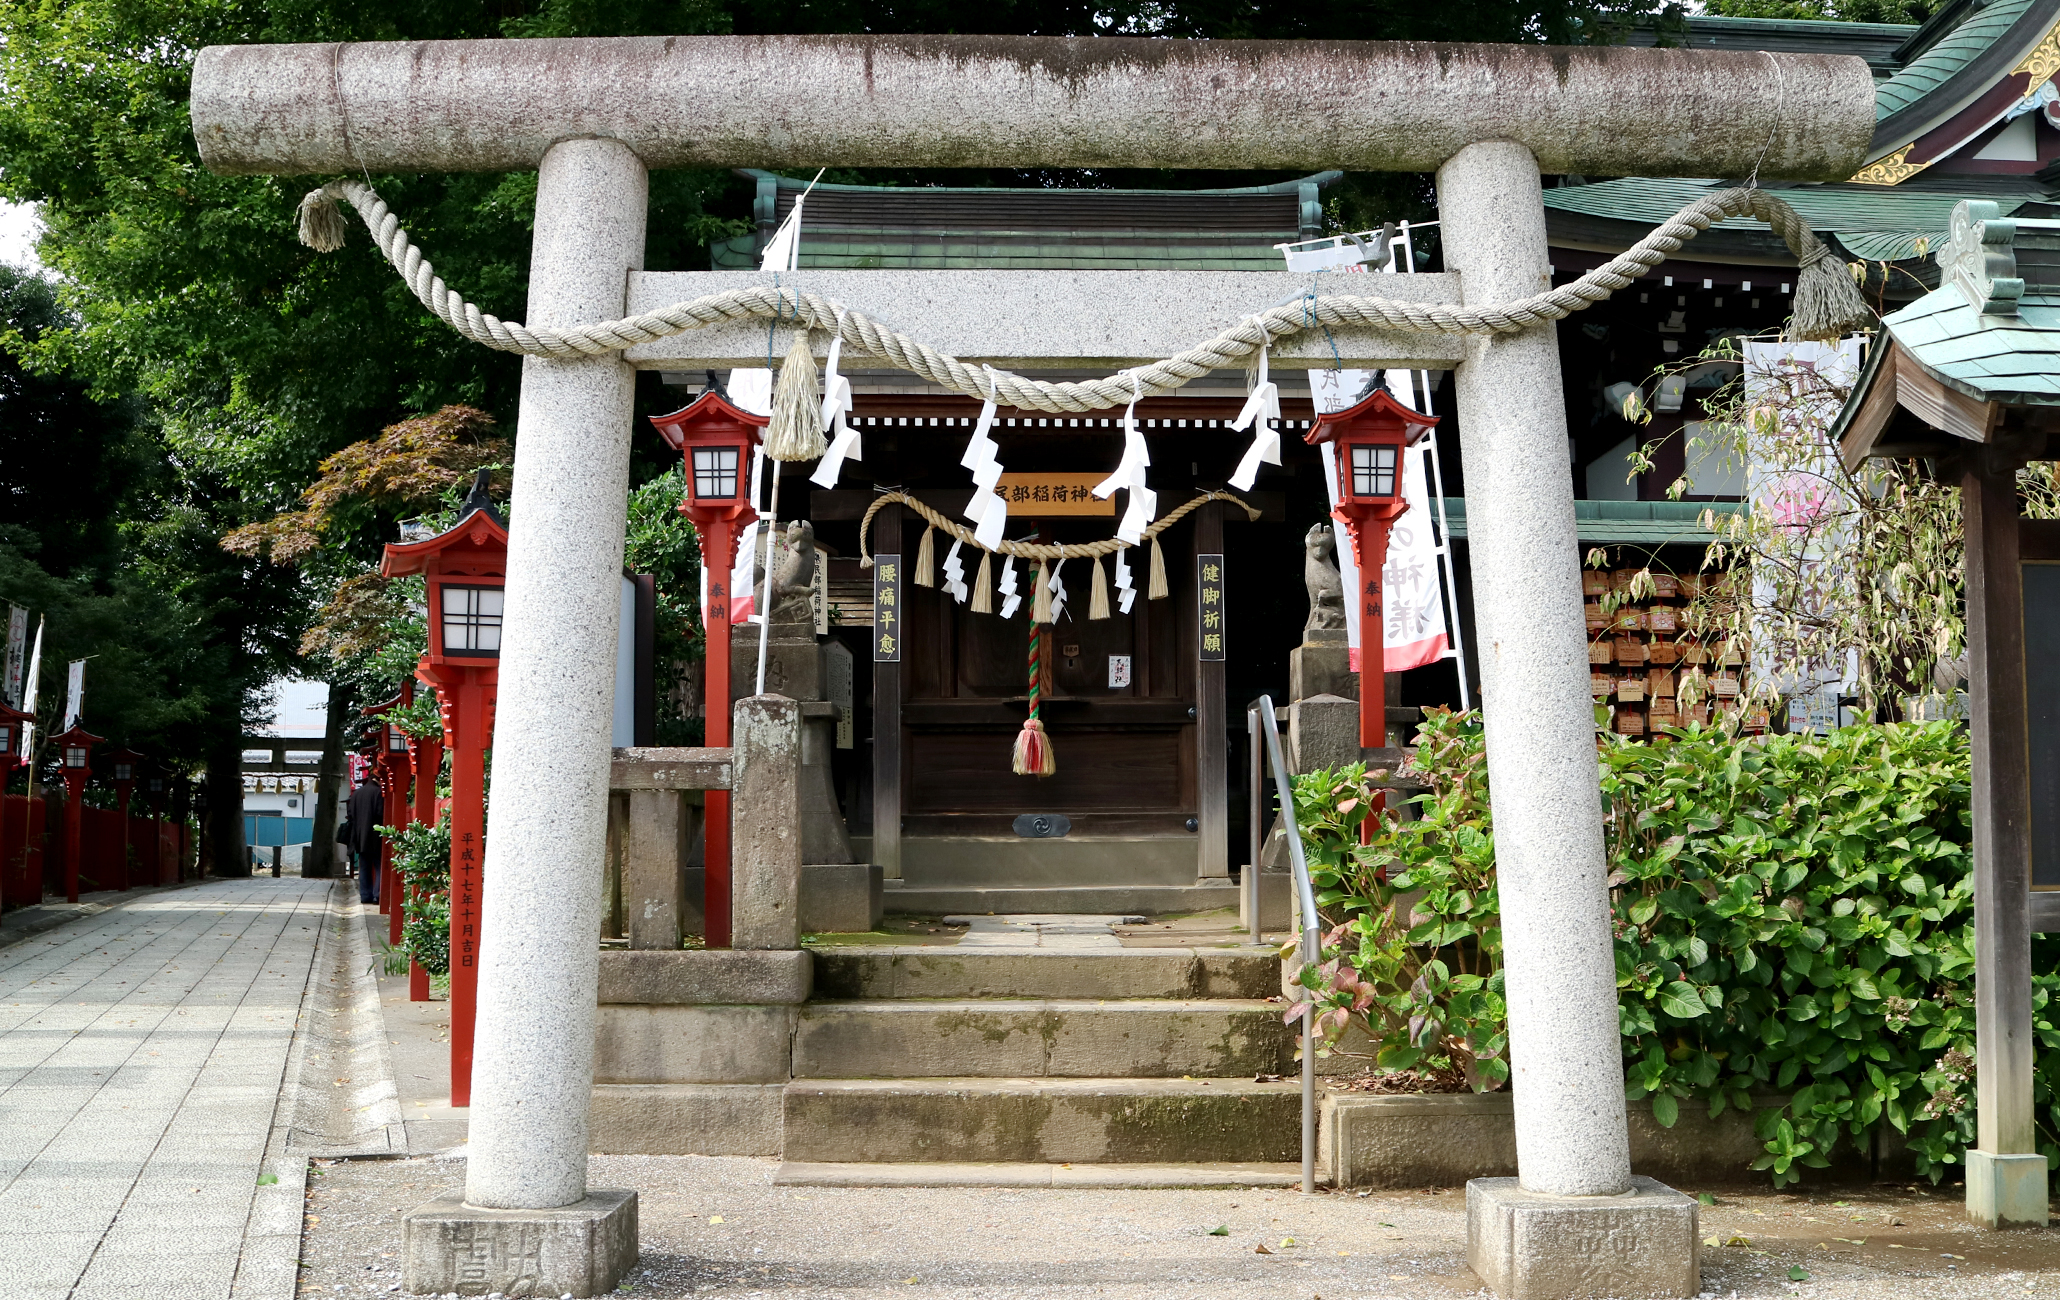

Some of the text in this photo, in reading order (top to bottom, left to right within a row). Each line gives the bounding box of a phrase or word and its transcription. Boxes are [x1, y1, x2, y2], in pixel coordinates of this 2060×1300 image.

[709, 581, 725, 620] 奉納
[1202, 563, 1221, 652] 健脚祈願
[1364, 580, 1381, 617] 奉納
[460, 832, 475, 968] 平成十七年十月吉日
